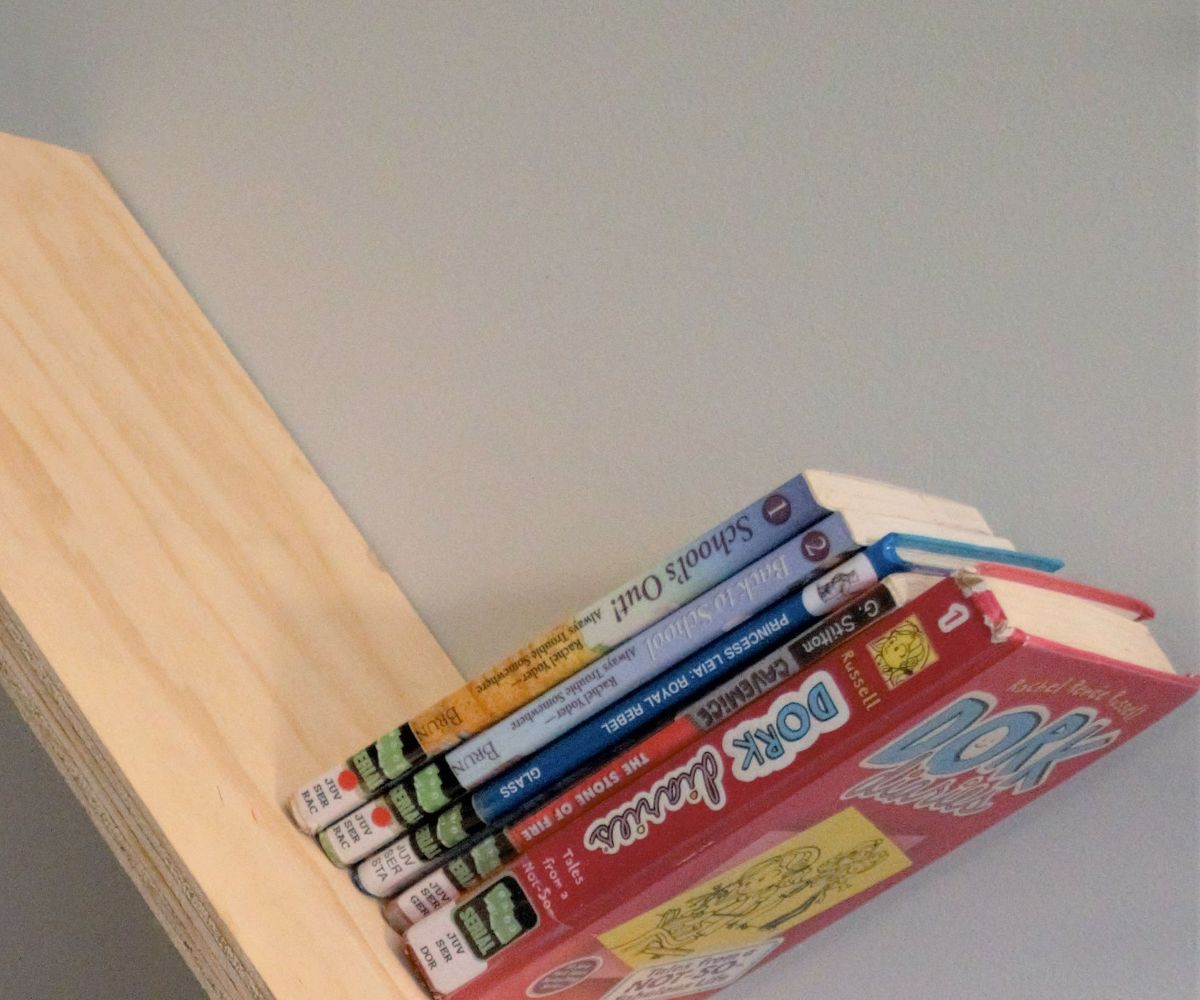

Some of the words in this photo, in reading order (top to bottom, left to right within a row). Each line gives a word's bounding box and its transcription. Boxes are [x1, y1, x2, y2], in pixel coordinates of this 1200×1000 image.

[765, 499, 788, 519] 1
[660, 513, 758, 587] School's
[734, 555, 791, 601] Back
[604, 570, 667, 622] Out!
[710, 587, 738, 614] to
[856, 596, 881, 620] G.
[565, 607, 604, 638] Always
[639, 601, 716, 661] School
[721, 611, 790, 661] PRINCESS
[800, 613, 855, 658] Stilton
[527, 630, 569, 662] Trouble
[550, 638, 584, 665] Rachel
[599, 644, 638, 675] Always
[473, 653, 532, 695] Somewhere
[687, 652, 724, 682] LEIA:
[833, 648, 885, 712] Russell
[561, 666, 603, 698] Trouble
[583, 675, 618, 702] Rachel
[642, 673, 690, 710] ROYAL
[508, 690, 565, 732] Somewhere
[599, 701, 644, 736] REBEL
[731, 682, 840, 774] DORK
[863, 697, 1117, 790] DORK
[619, 751, 649, 776] THE
[310, 783, 331, 808] SER
[322, 776, 344, 801] JUV
[498, 765, 542, 799] GLASS
[572, 769, 621, 806] STONE
[298, 790, 320, 815] RAC
[551, 800, 573, 820] OF
[586, 751, 724, 853] diaries
[330, 825, 352, 851] RAC
[341, 819, 362, 844] SER
[352, 812, 373, 837] JUV
[518, 814, 552, 841] FIRE
[368, 856, 392, 883] STA
[381, 849, 404, 876] SER
[393, 843, 416, 869] JUV
[556, 847, 589, 886] Tales
[538, 855, 569, 892] from
[558, 889, 569, 900] a
[409, 893, 430, 917] GER
[420, 886, 441, 911] SER
[428, 879, 450, 905] JUV
[418, 945, 439, 970] DOR
[433, 938, 455, 963] SER
[445, 930, 467, 957] JUV
